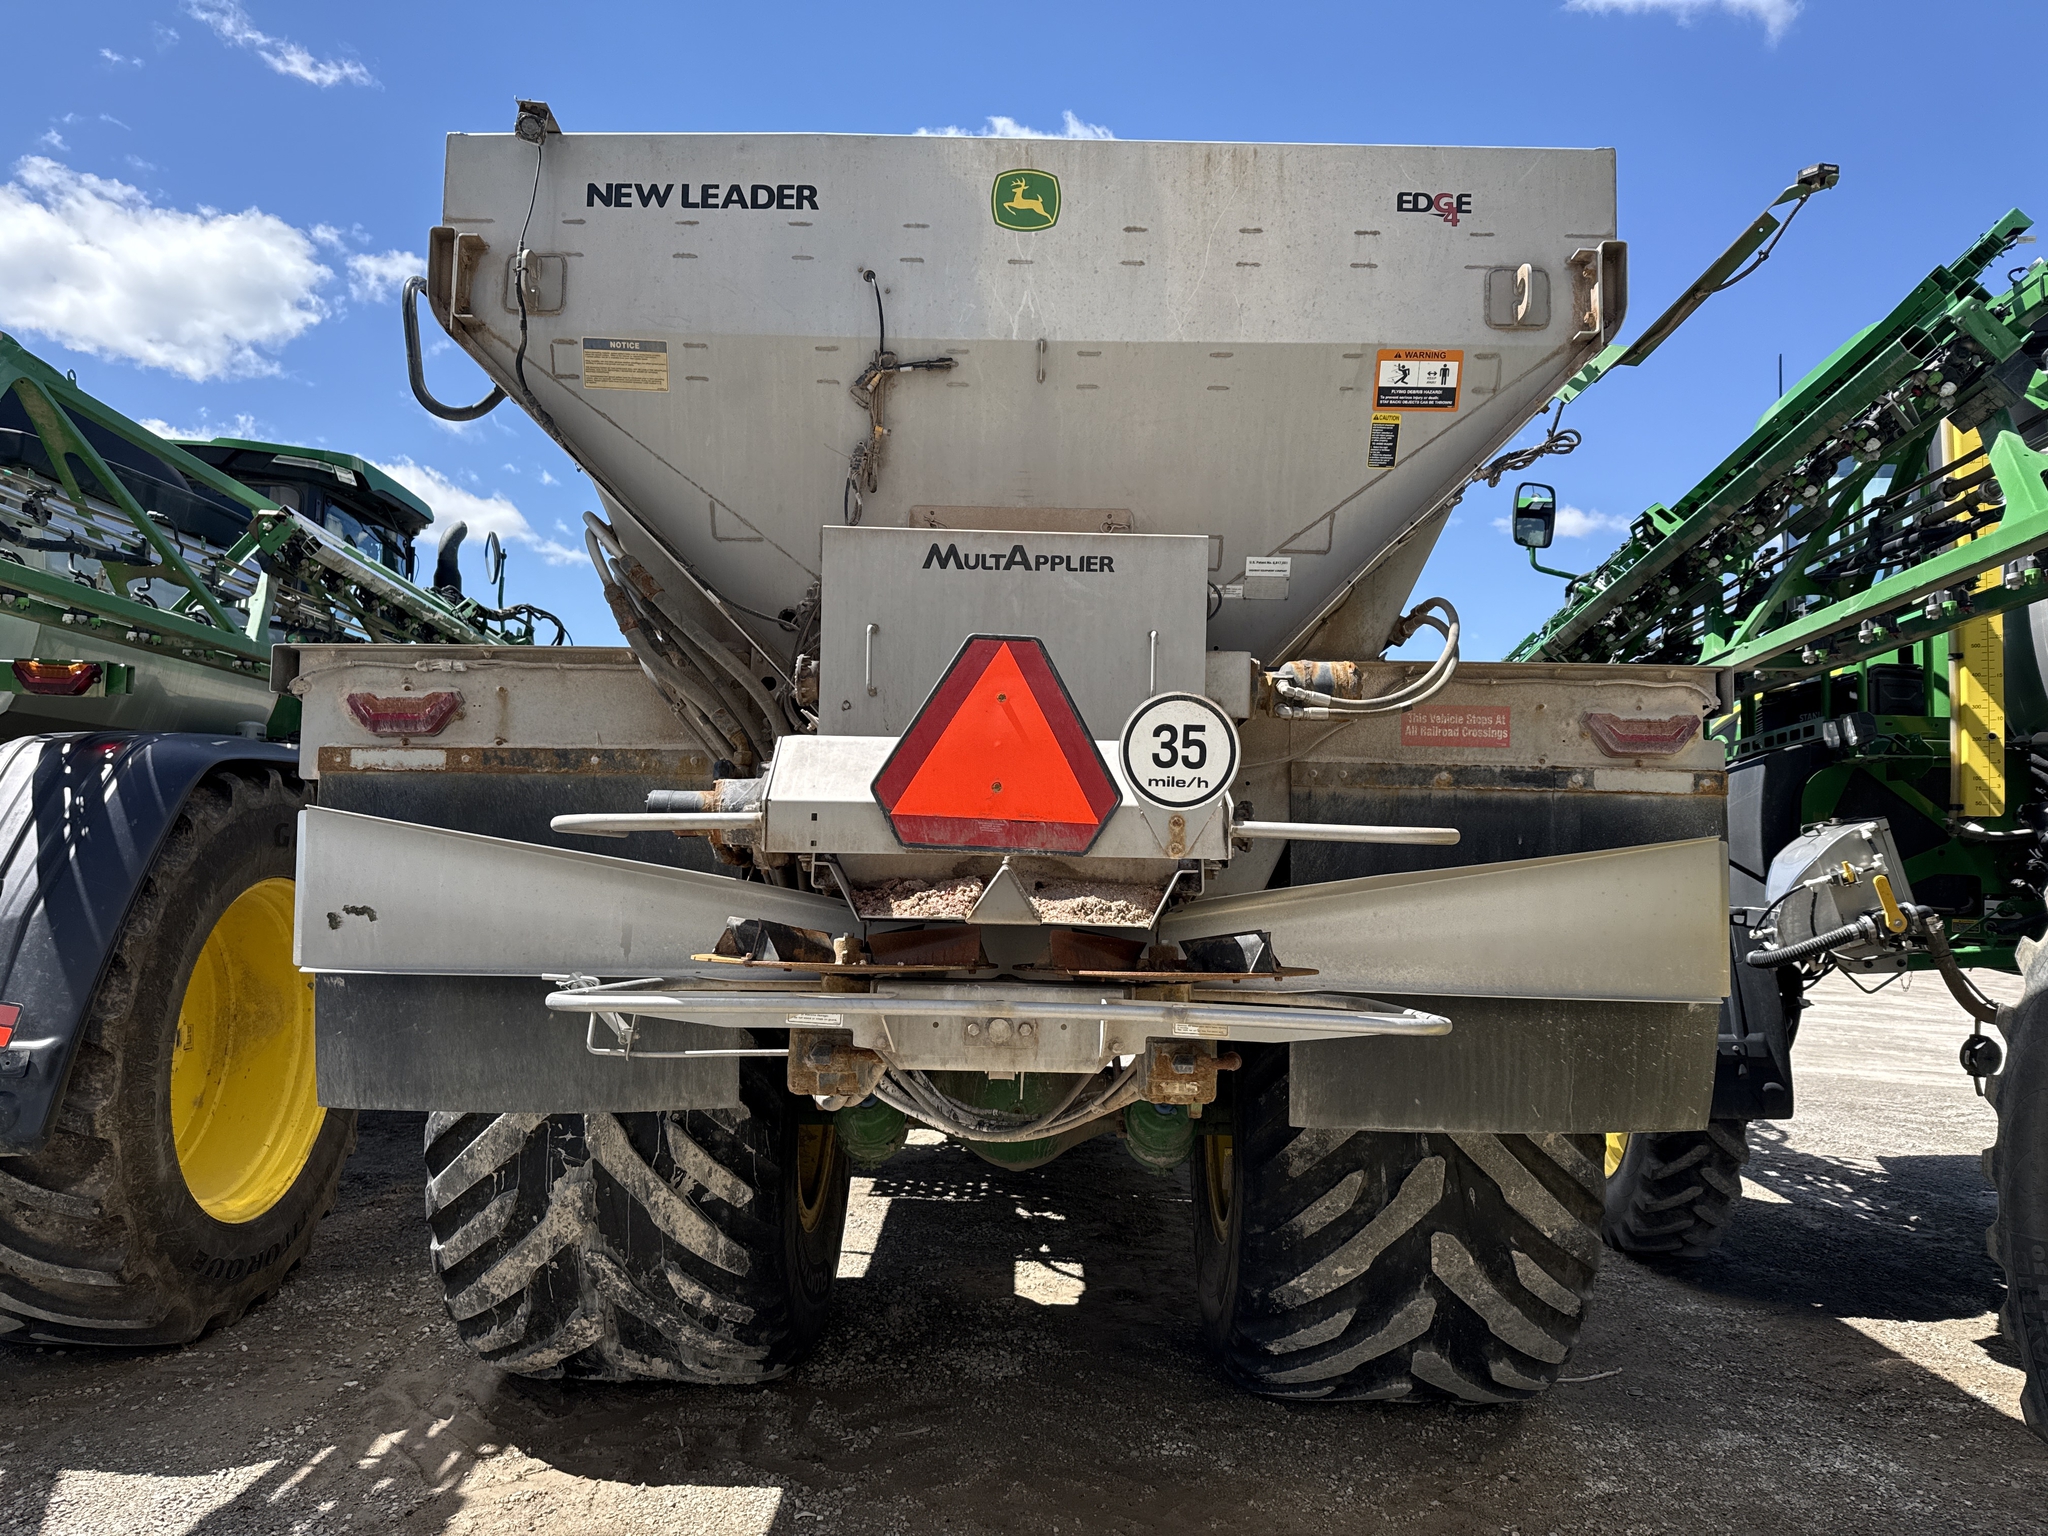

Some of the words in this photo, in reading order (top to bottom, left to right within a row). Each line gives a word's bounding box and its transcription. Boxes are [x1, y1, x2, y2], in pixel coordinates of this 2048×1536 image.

[586, 182, 674, 208] NEW
[681, 183, 819, 210] LEADER
[1396, 191, 1472, 214] EDGE
[1443, 202, 1460, 227] 4
[609, 341, 640, 350] NOTICE
[1404, 351, 1447, 359] WARNING
[1408, 713, 1427, 724] This
[1430, 713, 1464, 725] Vehicle
[1466, 714, 1493, 727] Stops
[1495, 714, 1506, 725] At
[1405, 725, 1418, 736] All
[1420, 726, 1459, 737] Railroad
[1462, 726, 1509, 740] Crossings
[1152, 723, 1207, 770] 35
[1148, 775, 1209, 789] mile/h
